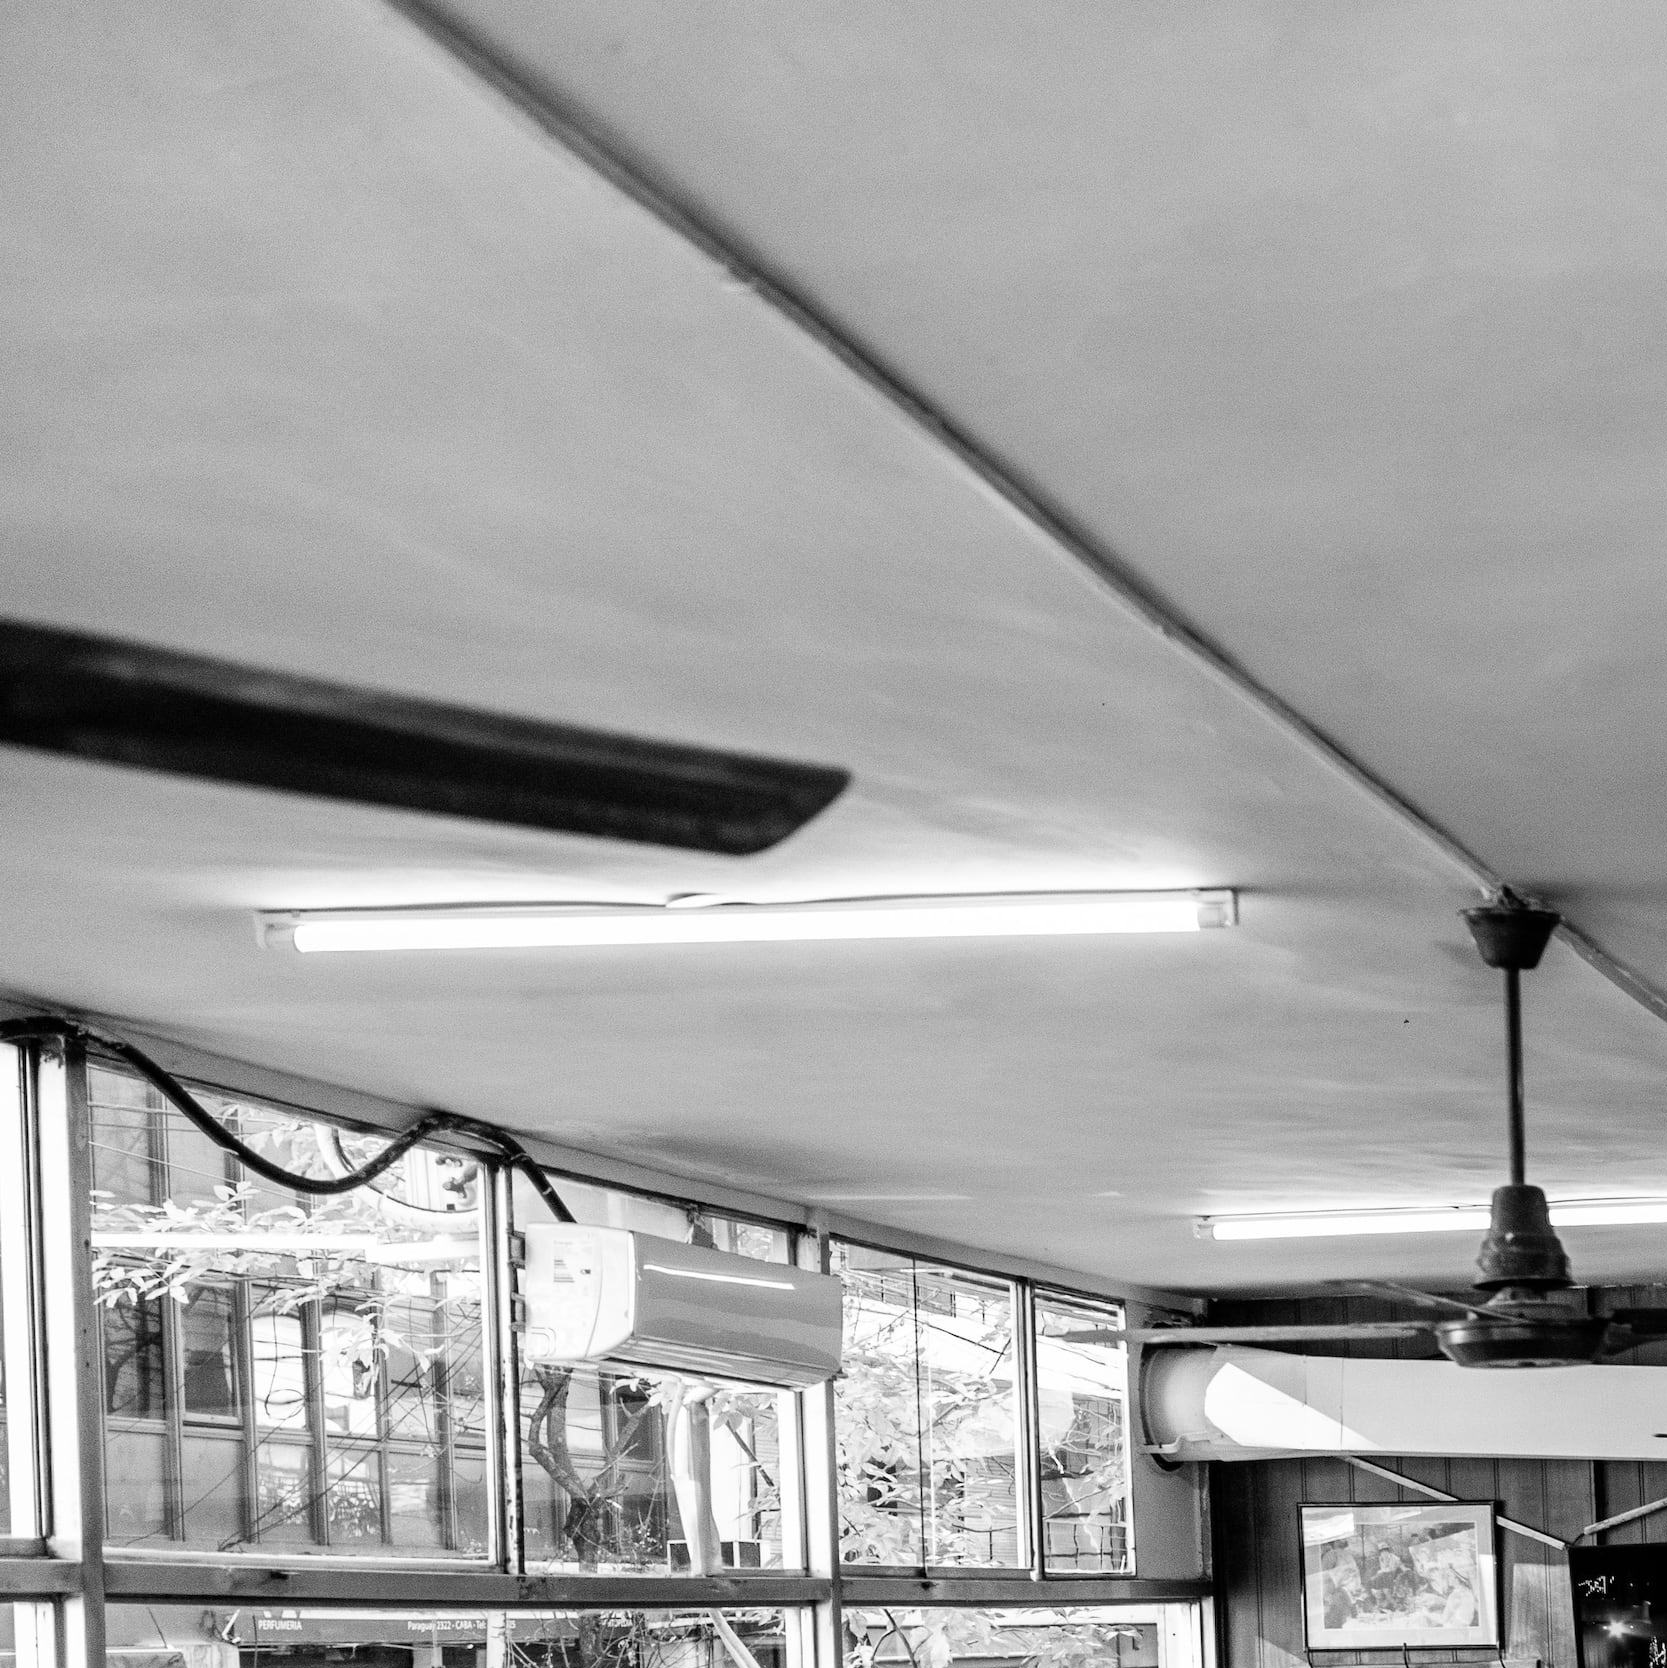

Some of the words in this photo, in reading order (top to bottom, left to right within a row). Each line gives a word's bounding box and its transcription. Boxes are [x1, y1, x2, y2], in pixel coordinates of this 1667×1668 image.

[258, 1620, 302, 1631] PERFUMERIA
[408, 1620, 436, 1633] Paraguay
[455, 1621, 473, 1630] CABA
